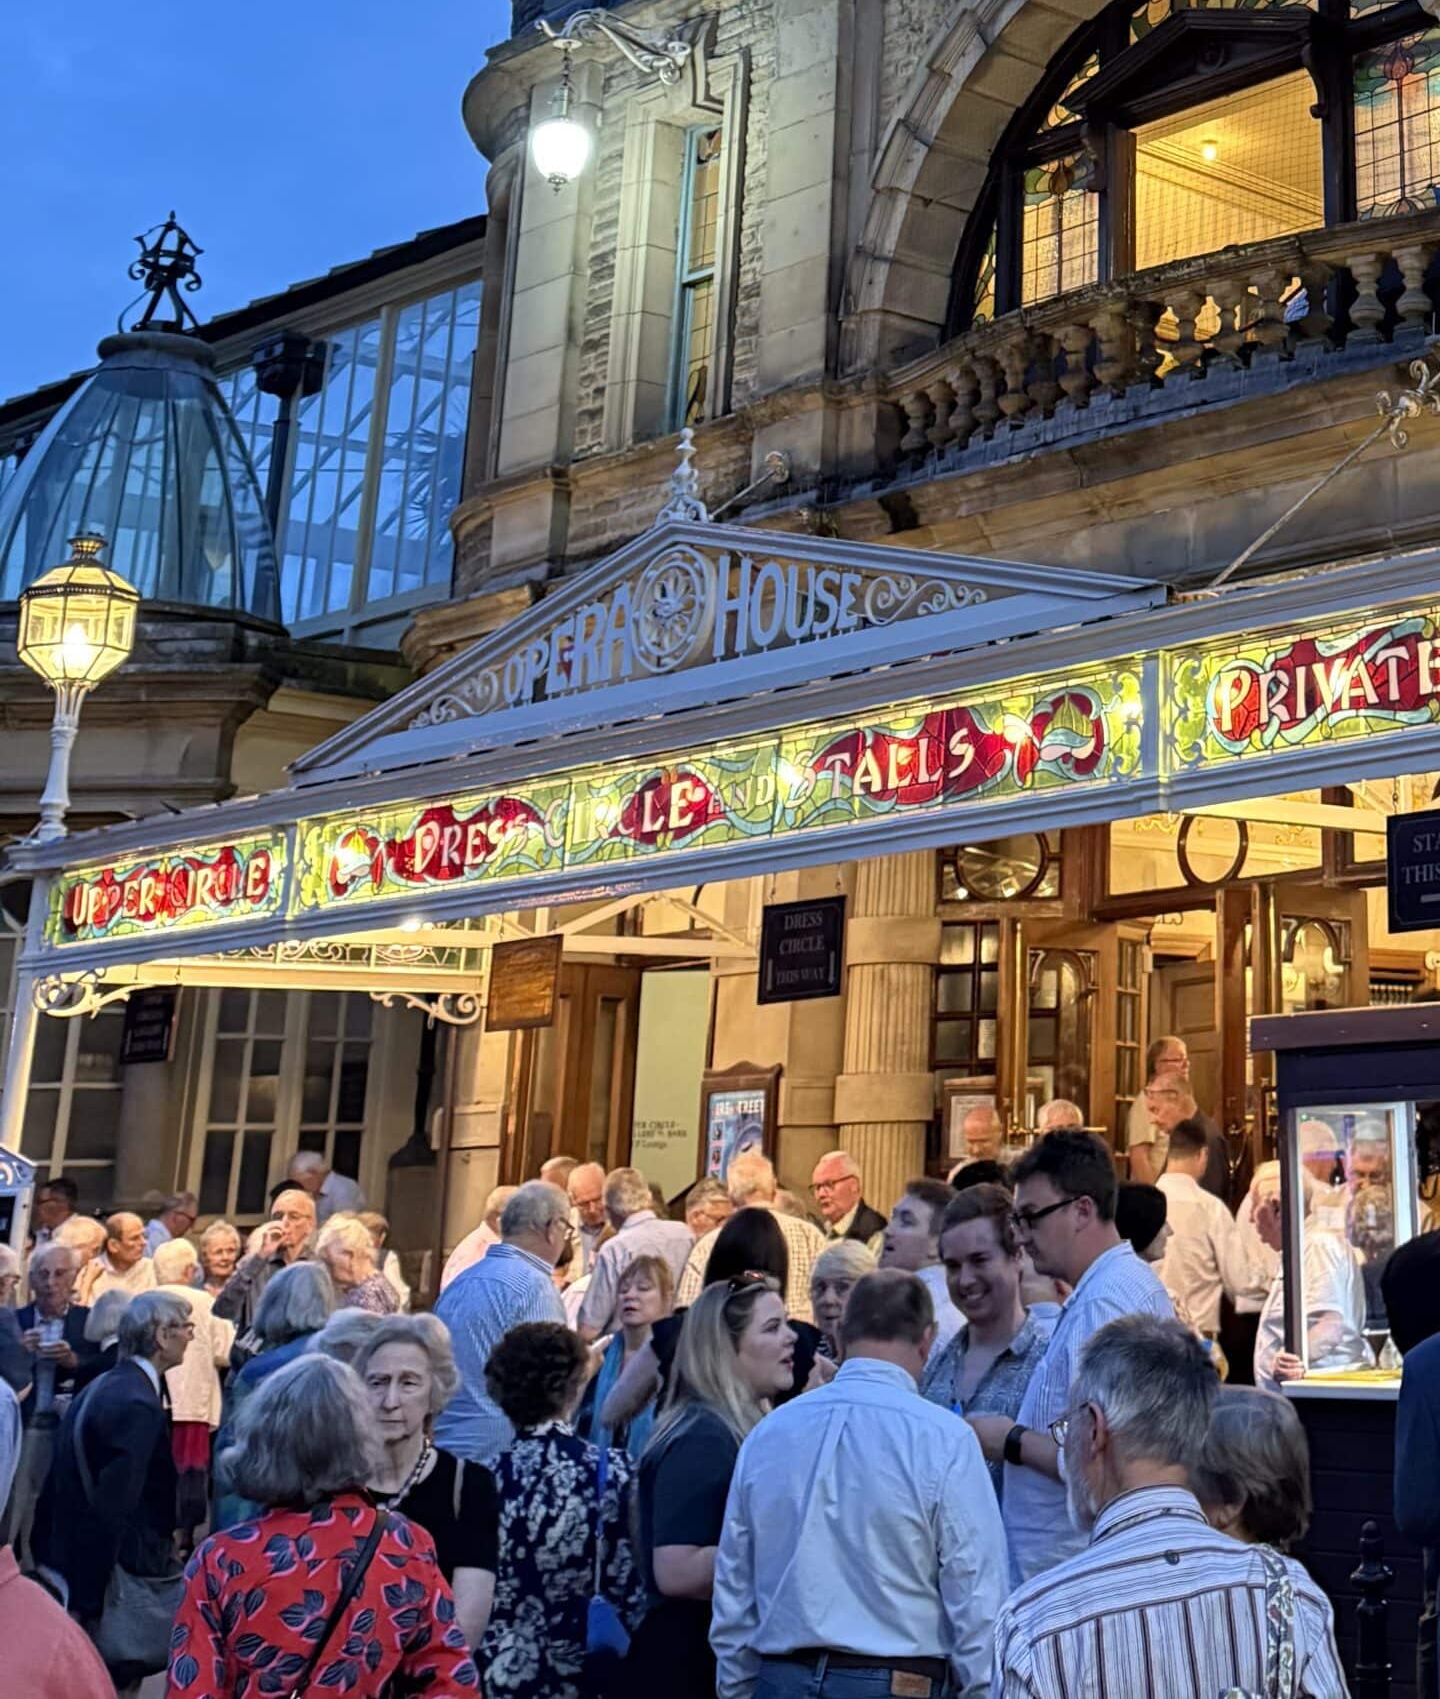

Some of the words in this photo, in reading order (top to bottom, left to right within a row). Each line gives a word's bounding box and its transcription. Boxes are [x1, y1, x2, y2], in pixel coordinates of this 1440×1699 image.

[504, 581, 633, 703] OPERA
[713, 555, 862, 658] HOUSE
[413, 813, 528, 874] DRESS
[544, 780, 695, 848] CIRCLE
[707, 775, 774, 815] AND
[785, 727, 975, 808] STALLS
[72, 876, 155, 925] UPPER
[169, 856, 266, 907] CIRCLE
[784, 910, 823, 930] DRESS
[779, 935, 825, 955] CIRCLE
[801, 966, 825, 981] WAY
